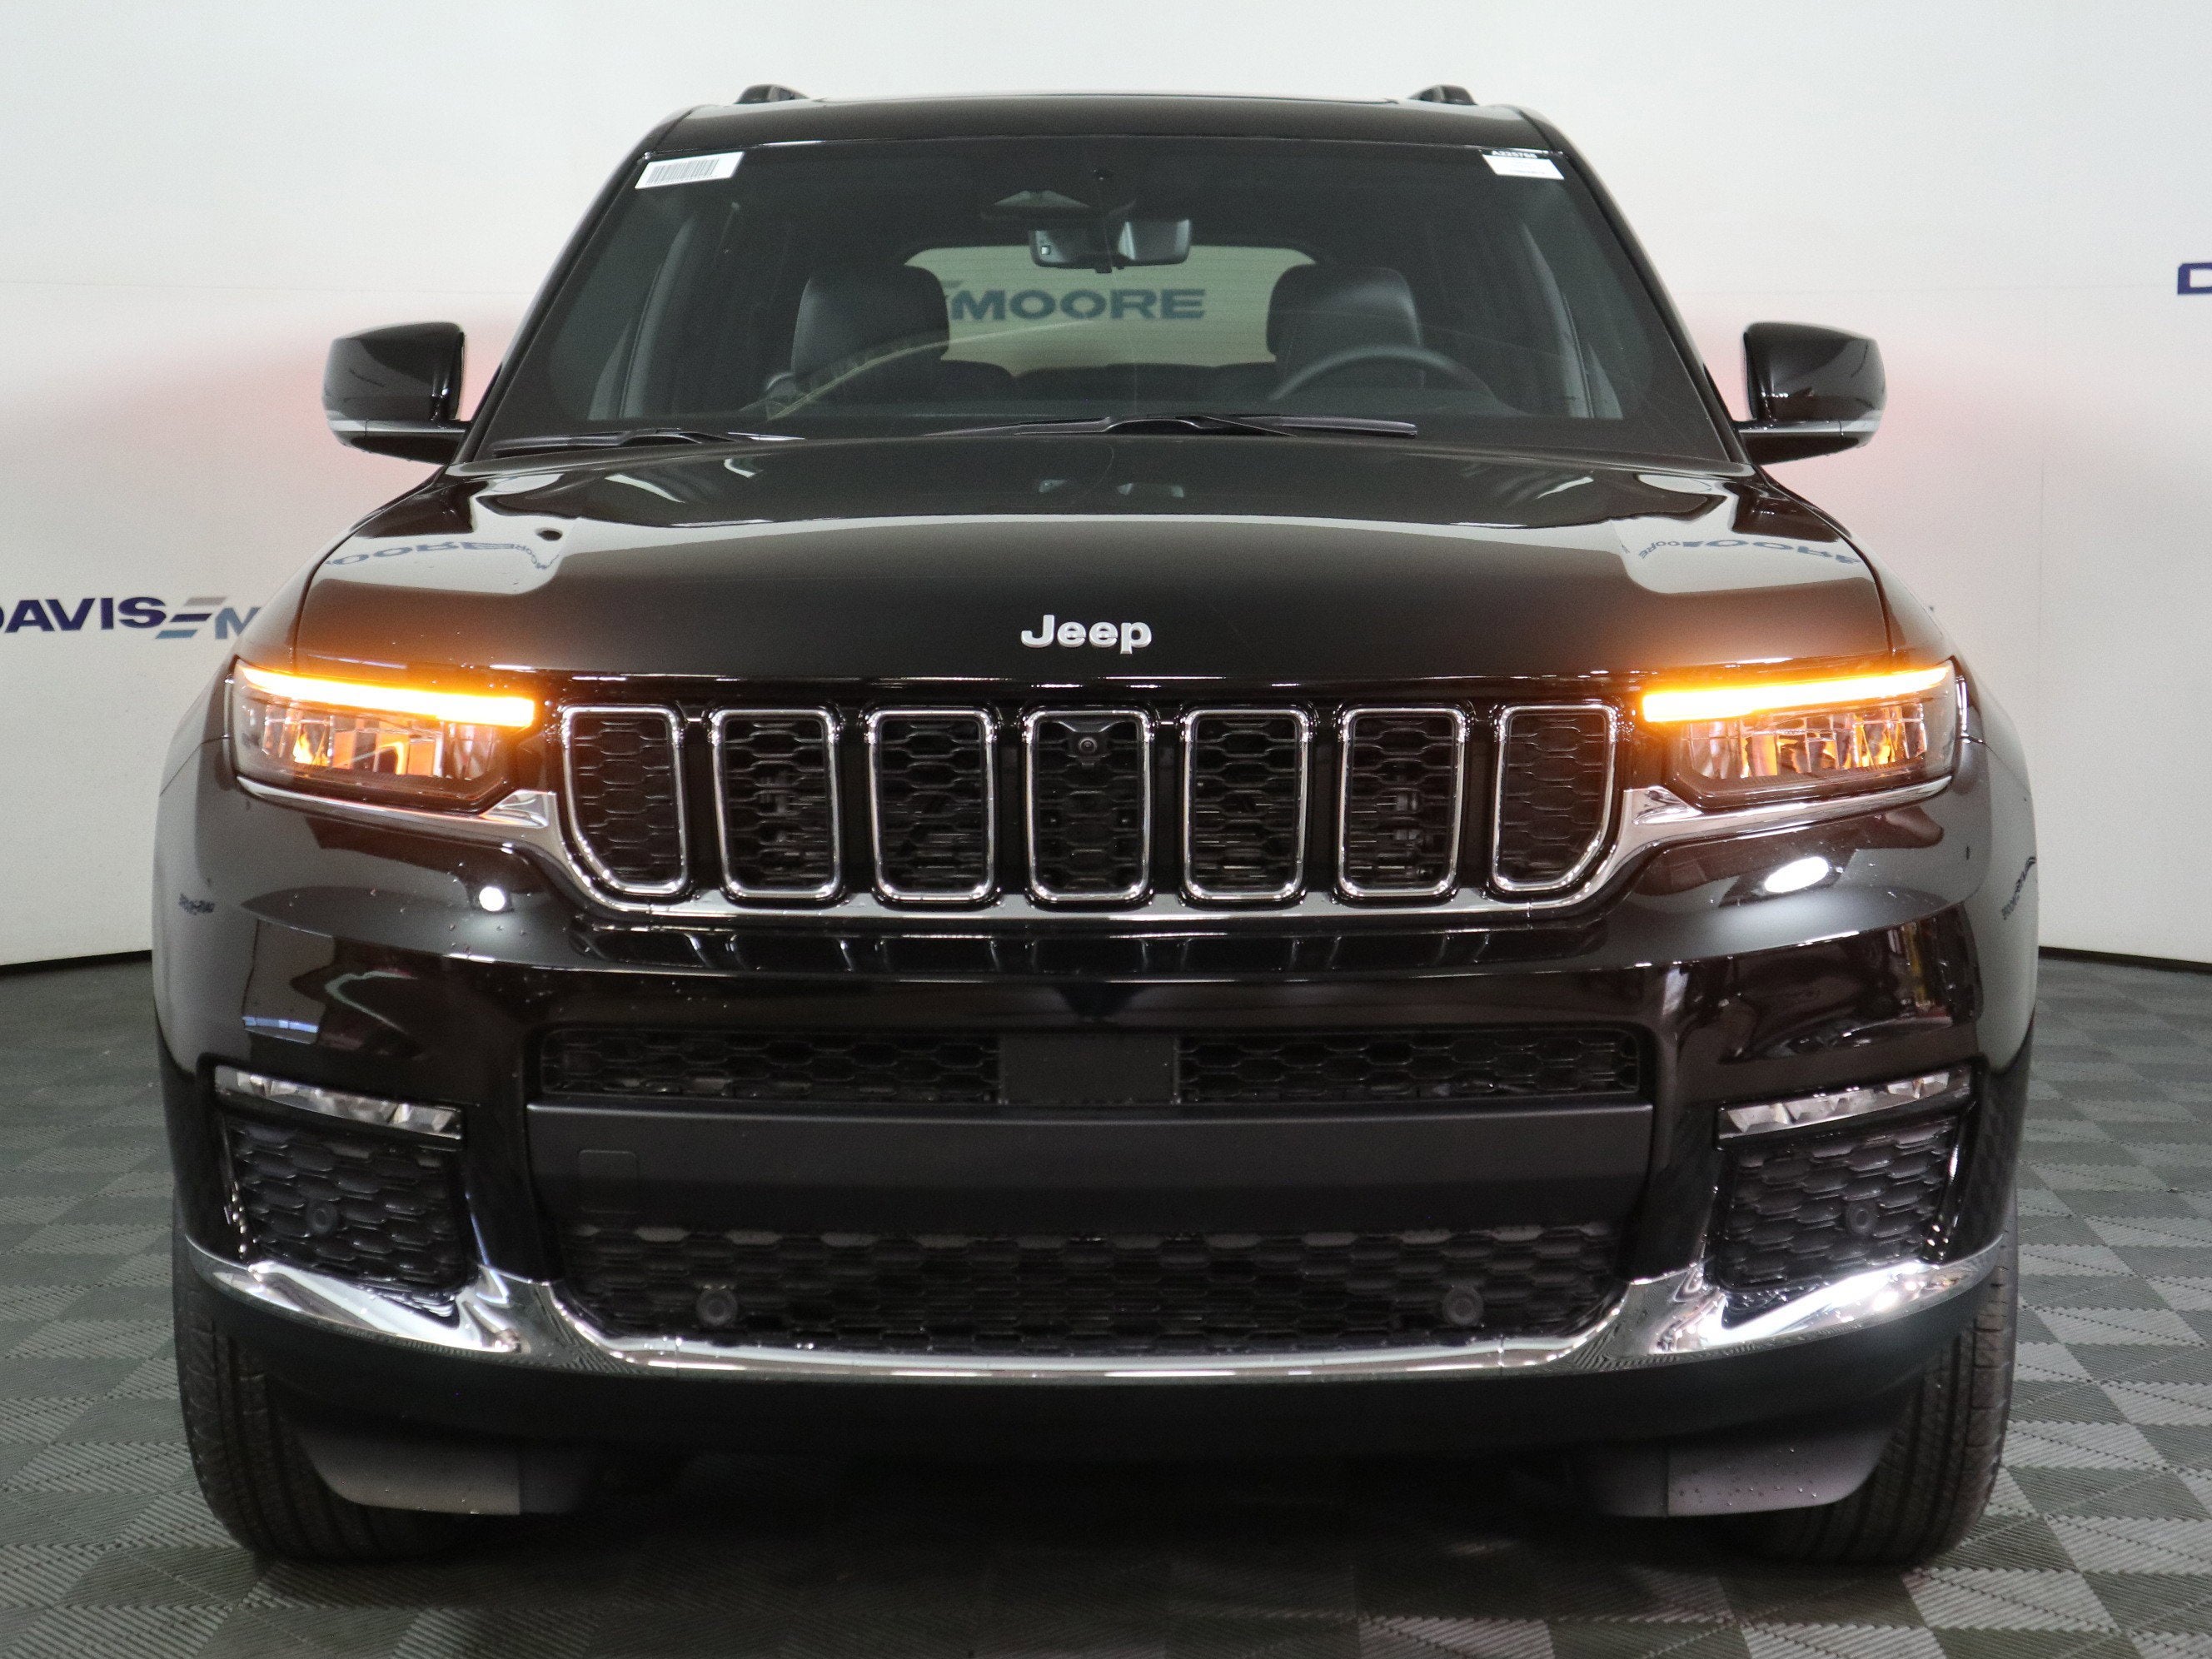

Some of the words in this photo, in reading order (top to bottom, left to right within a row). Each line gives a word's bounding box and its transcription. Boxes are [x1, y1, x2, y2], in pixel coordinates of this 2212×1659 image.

[950, 288, 1205, 321] MOORE
[0, 596, 167, 633] AVIS
[1020, 614, 1152, 655] Jeep
